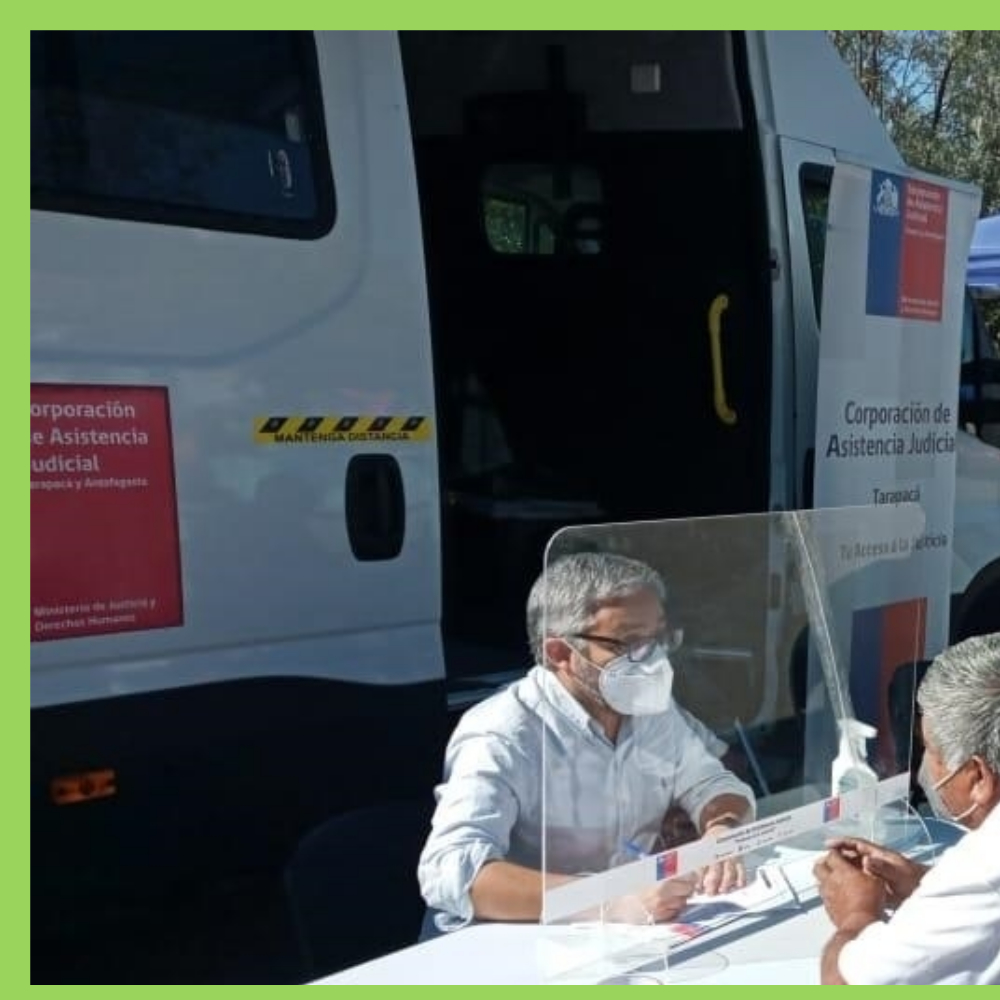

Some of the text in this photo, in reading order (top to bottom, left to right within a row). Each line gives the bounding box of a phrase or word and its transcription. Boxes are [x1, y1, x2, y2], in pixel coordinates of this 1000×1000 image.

[30, 400, 135, 422] orporación
[844, 401, 951, 430] Corporación de
[50, 427, 149, 446] Asistencia
[273, 432, 411, 444] MANTENGA DISTANCIA
[826, 432, 956, 458] Asistencia Judicia
[31, 454, 100, 473] udicial
